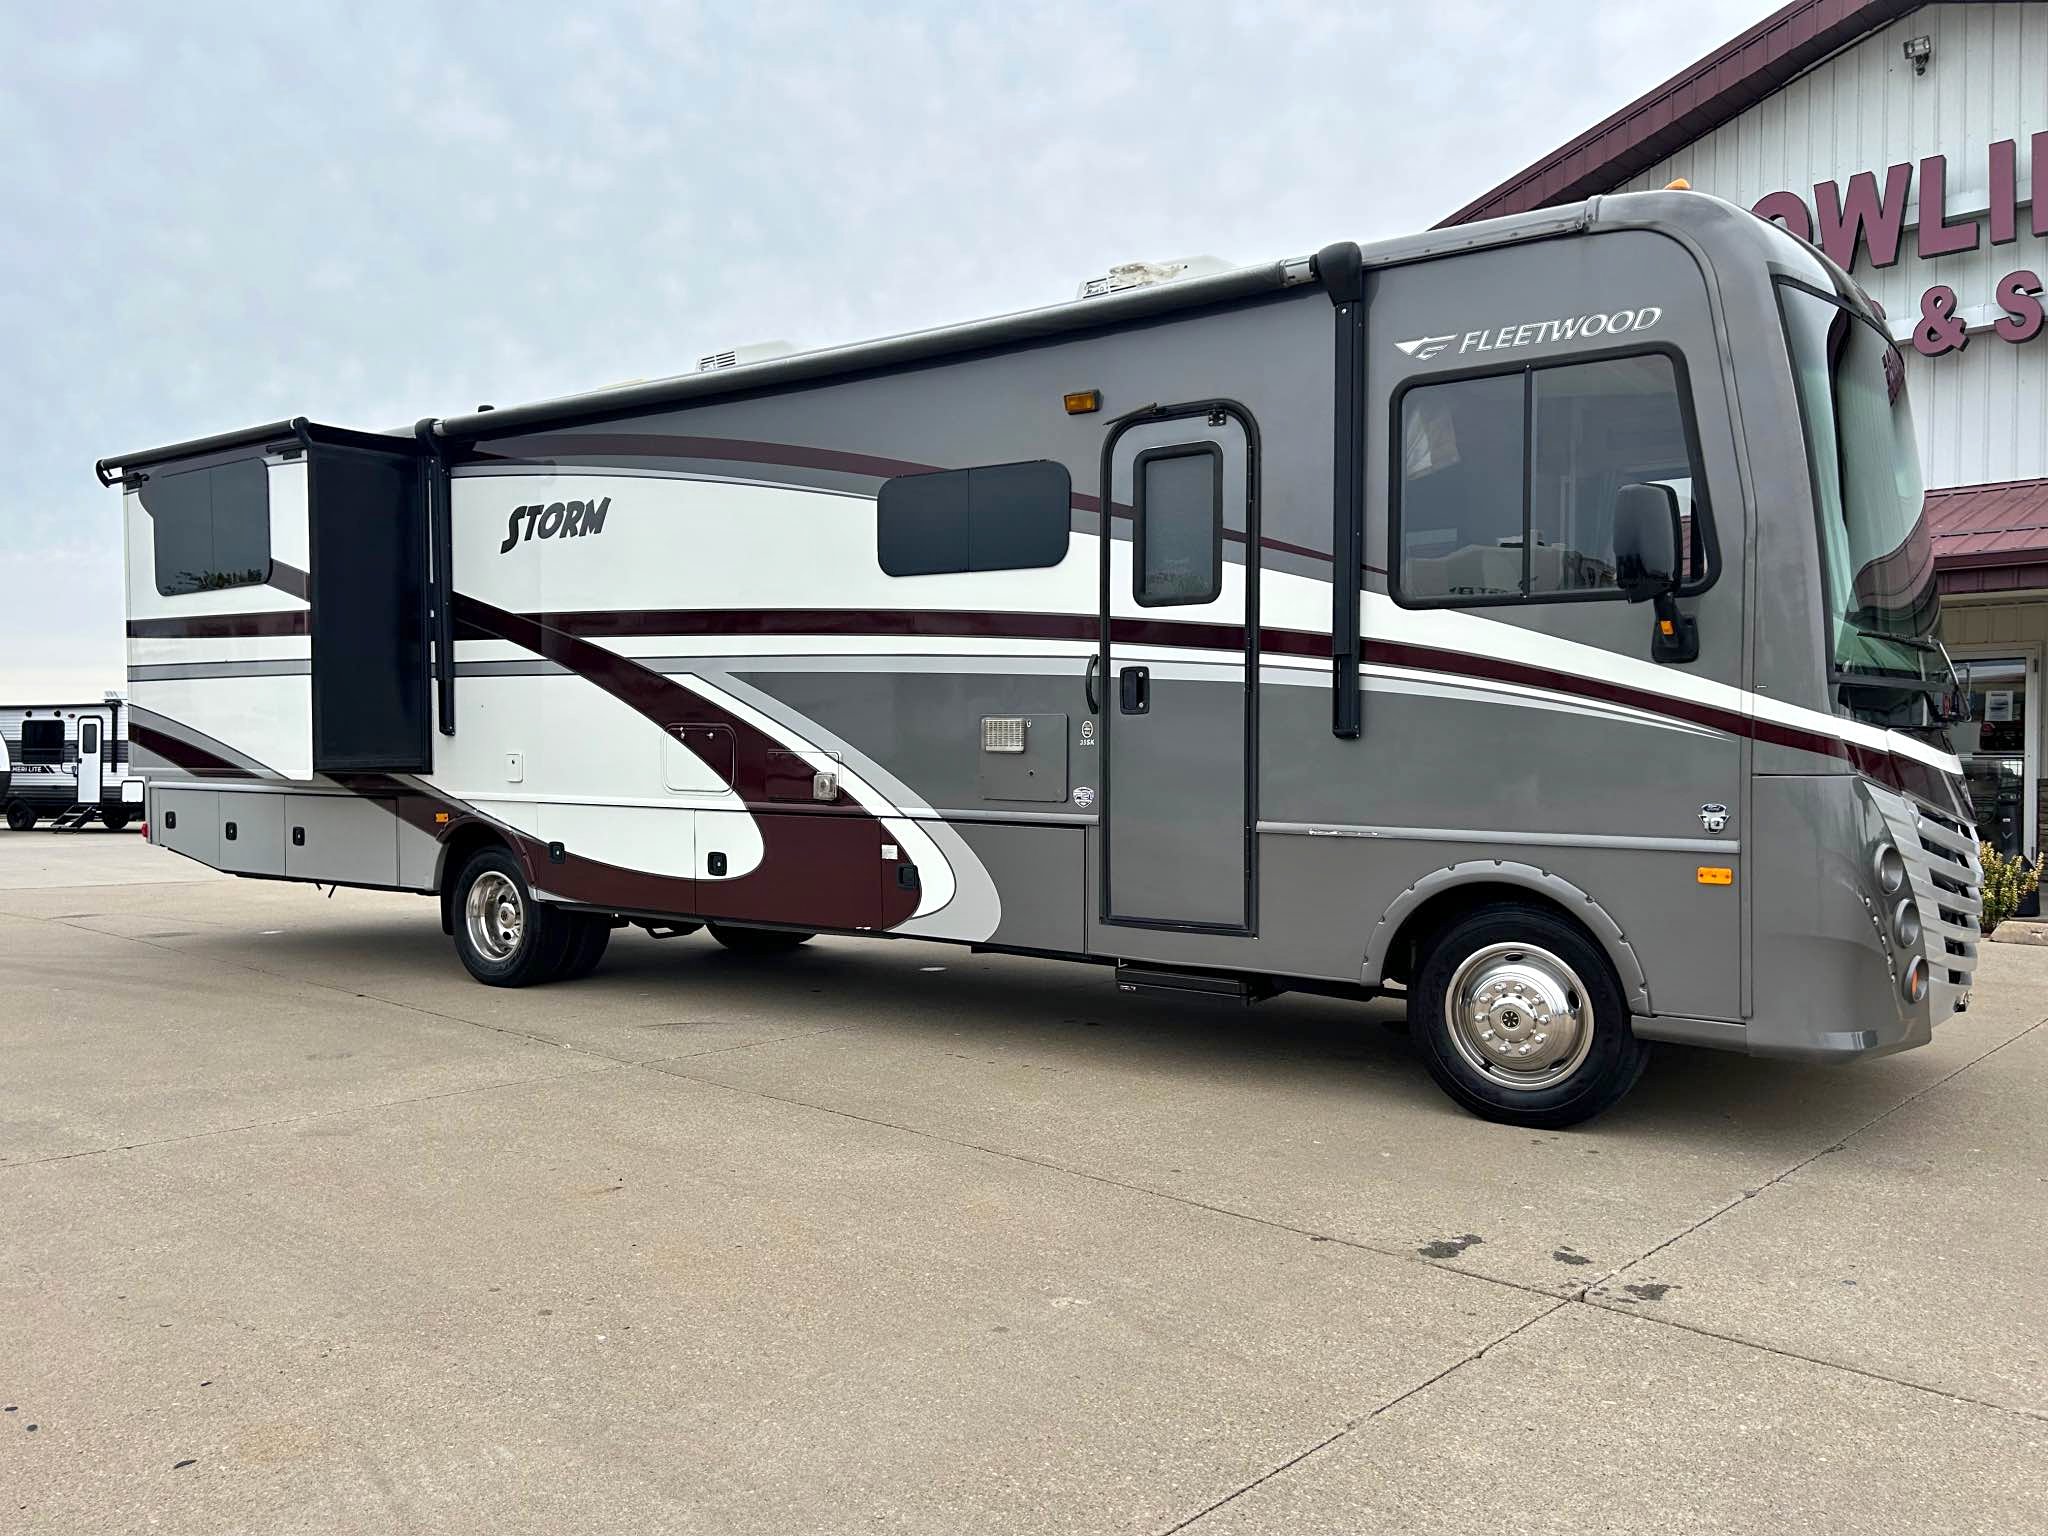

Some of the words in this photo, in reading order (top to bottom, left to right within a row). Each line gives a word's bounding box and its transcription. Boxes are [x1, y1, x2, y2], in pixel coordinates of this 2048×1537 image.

[1751, 131, 2048, 274] WLI
[1458, 306, 1662, 354] FLEETWOOD
[1912, 285, 1969, 357] &
[500, 496, 611, 554] STORM
